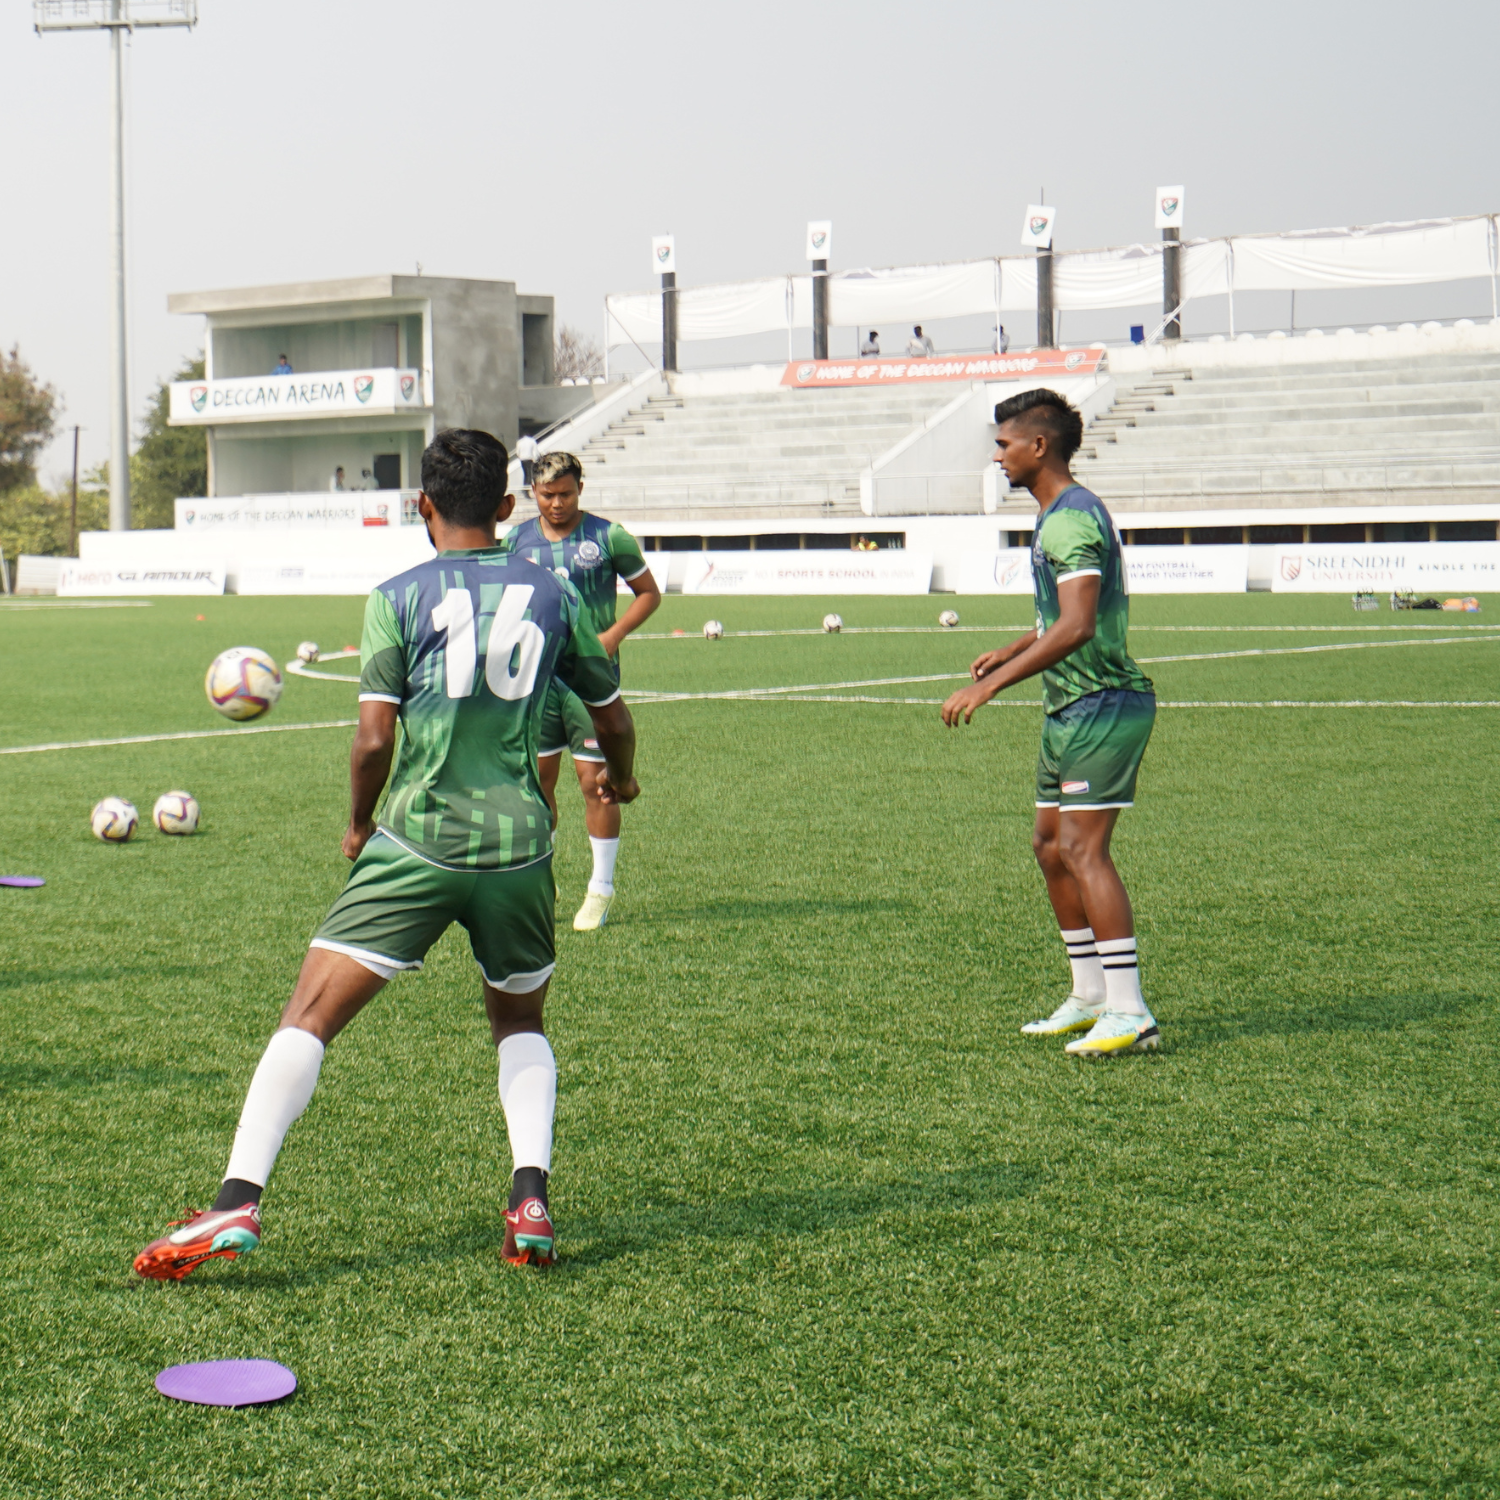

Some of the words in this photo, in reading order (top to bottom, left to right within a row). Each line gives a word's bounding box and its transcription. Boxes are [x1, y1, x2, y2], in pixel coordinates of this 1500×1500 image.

[816, 366, 856, 380] HOME
[857, 365, 878, 379] OF
[879, 364, 907, 379] THE
[907, 362, 965, 377] DECCAN
[965, 358, 1038, 375] WARRIORS
[213, 387, 280, 407] DECCAN
[287, 381, 345, 404] ARENA
[200, 512, 225, 523] HOME
[228, 511, 240, 522] OF
[244, 511, 261, 521] THE
[265, 510, 303, 521] DECCAN
[307, 509, 356, 520] WARRIORS
[1146, 561, 1195, 569] FOOTBALL
[1307, 556, 1405, 569] SREENIDHI
[1418, 563, 1465, 571] KINDLE
[1473, 563, 1496, 571] THE
[117, 571, 218, 586] GLAMOUR
[778, 570, 824, 579] SPORTS
[828, 569, 877, 579] SCHOOL
[1163, 571, 1214, 579] TOGETHER
[1311, 570, 1396, 581] UNIVERSITY
[431, 584, 546, 700] 16
